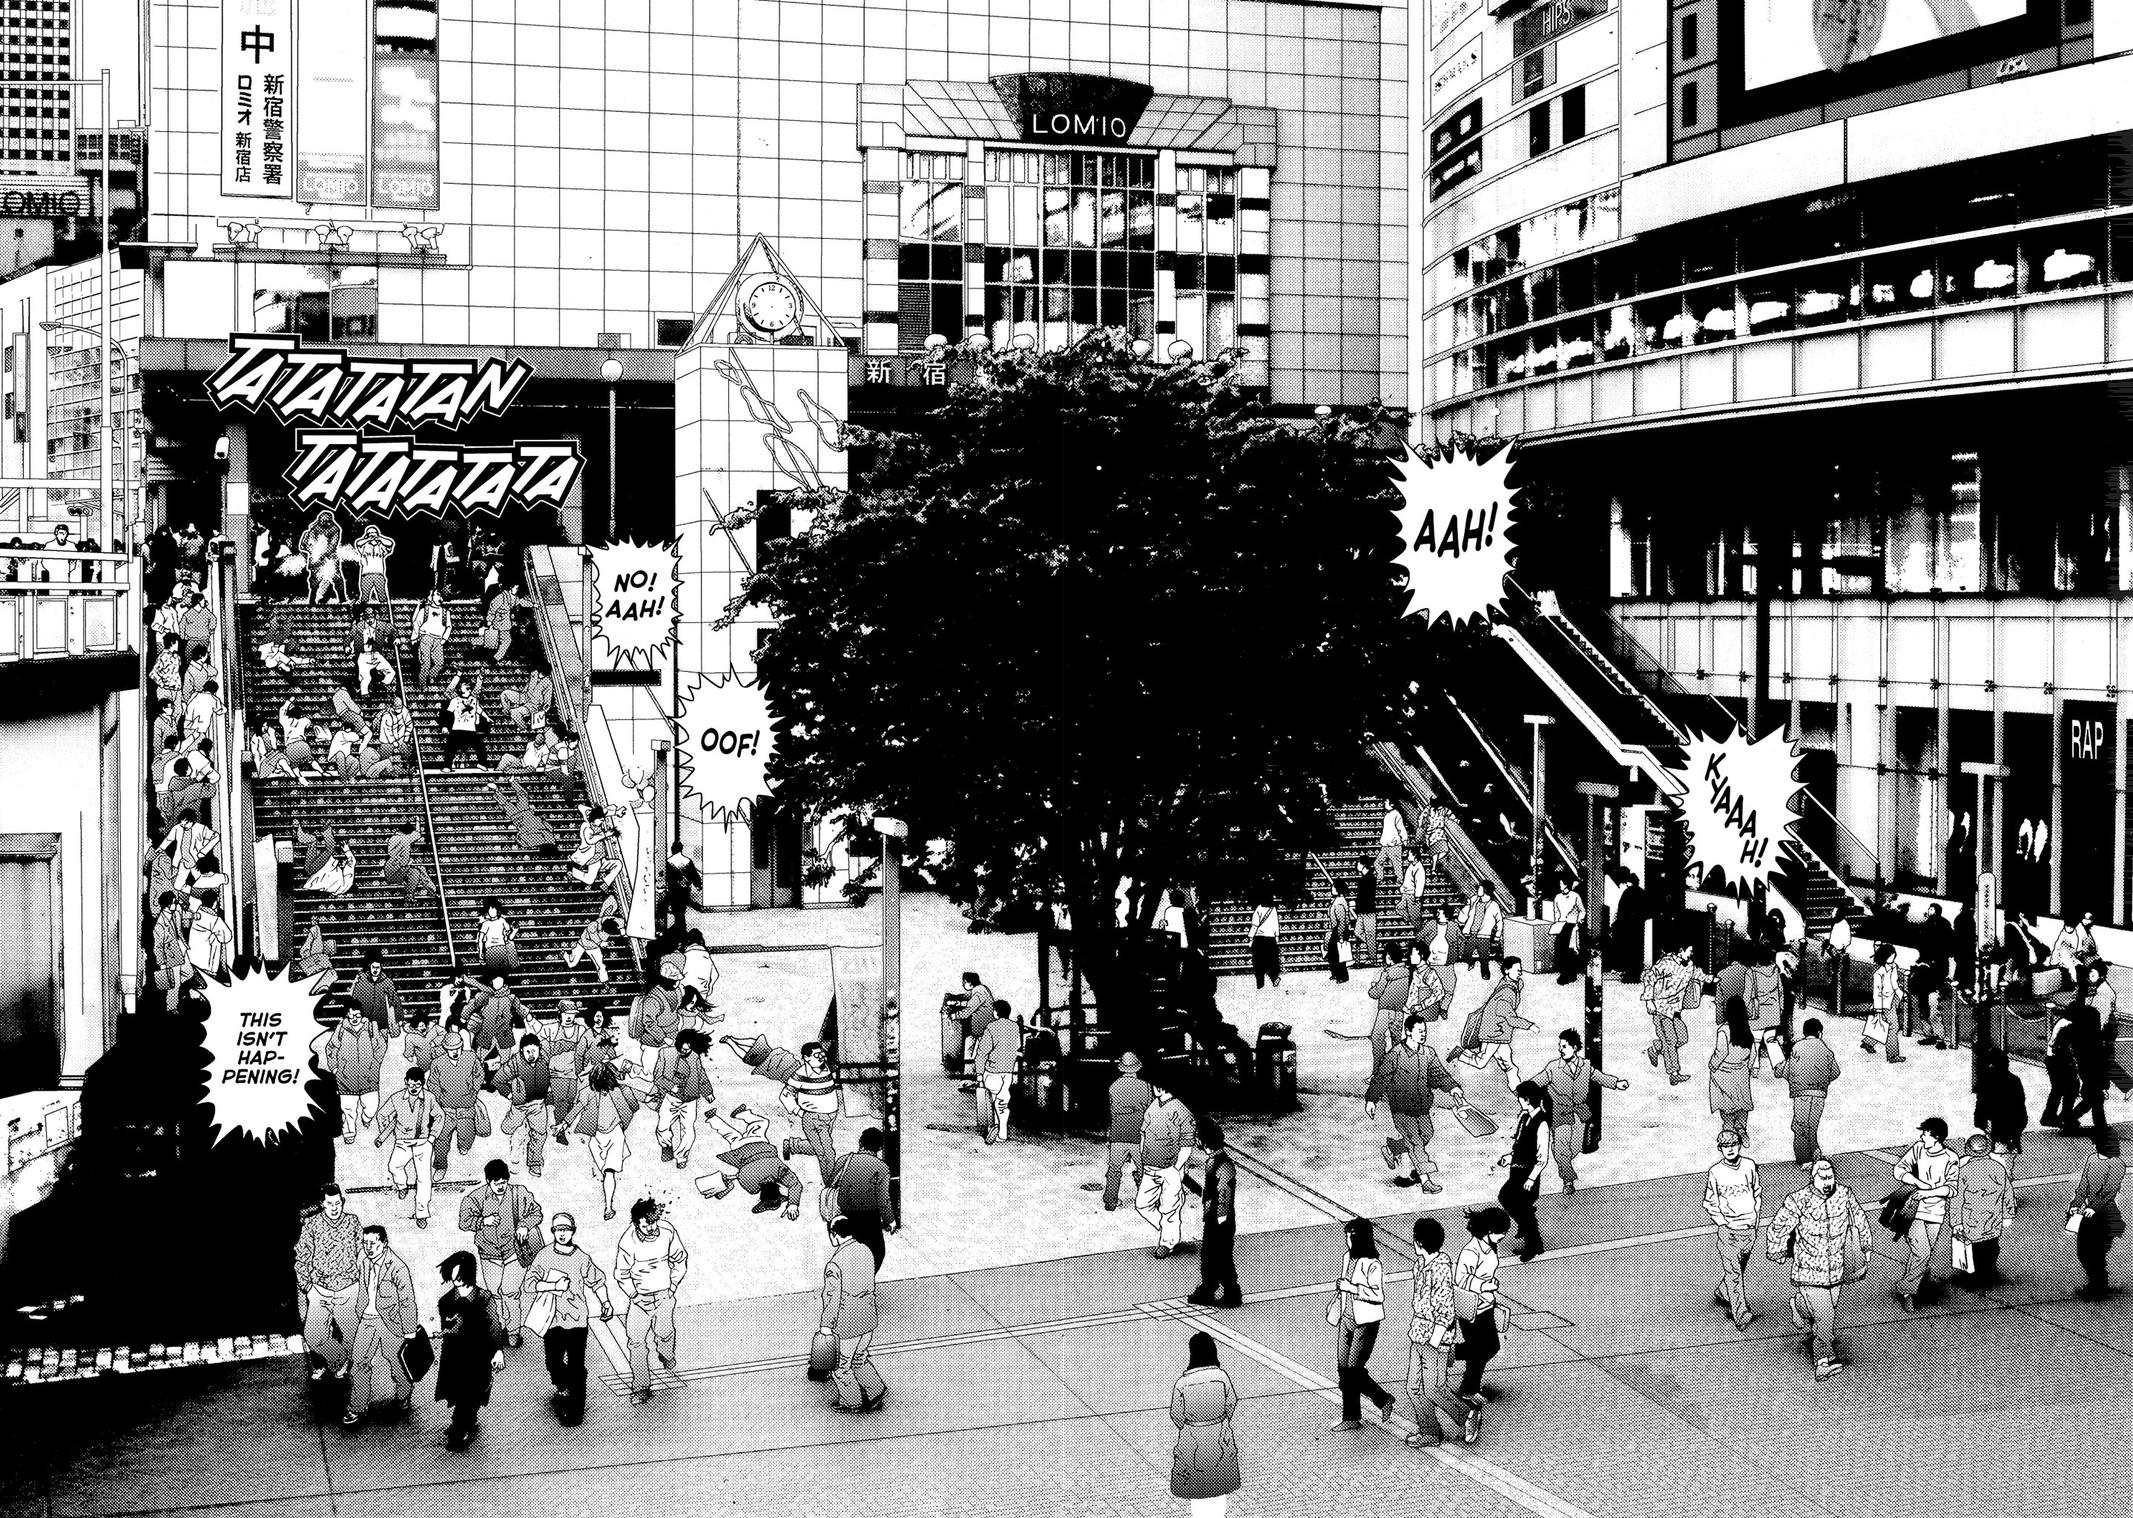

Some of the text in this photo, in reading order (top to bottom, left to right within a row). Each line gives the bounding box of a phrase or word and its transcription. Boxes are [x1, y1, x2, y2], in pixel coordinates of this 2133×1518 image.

[241, 25, 275, 64] 中
[235, 75, 252, 183] ロミオ 新宿店
[262, 74, 284, 185] 新宿警察署
[1033, 114, 1126, 138] LOMIO
[212, 338, 527, 425] TATATATAN
[1413, 501, 1498, 559] AAH!
[614, 570, 658, 593] NO!
[605, 596, 665, 621] AAH!
[700, 727, 760, 758] OOF!
[2071, 719, 2104, 760] RAP
[240, 1012, 282, 1028] THIS
[236, 1031, 288, 1047] ISN'T
[237, 1050, 285, 1066] HAP-
[221, 1068, 300, 1085] PENING!
